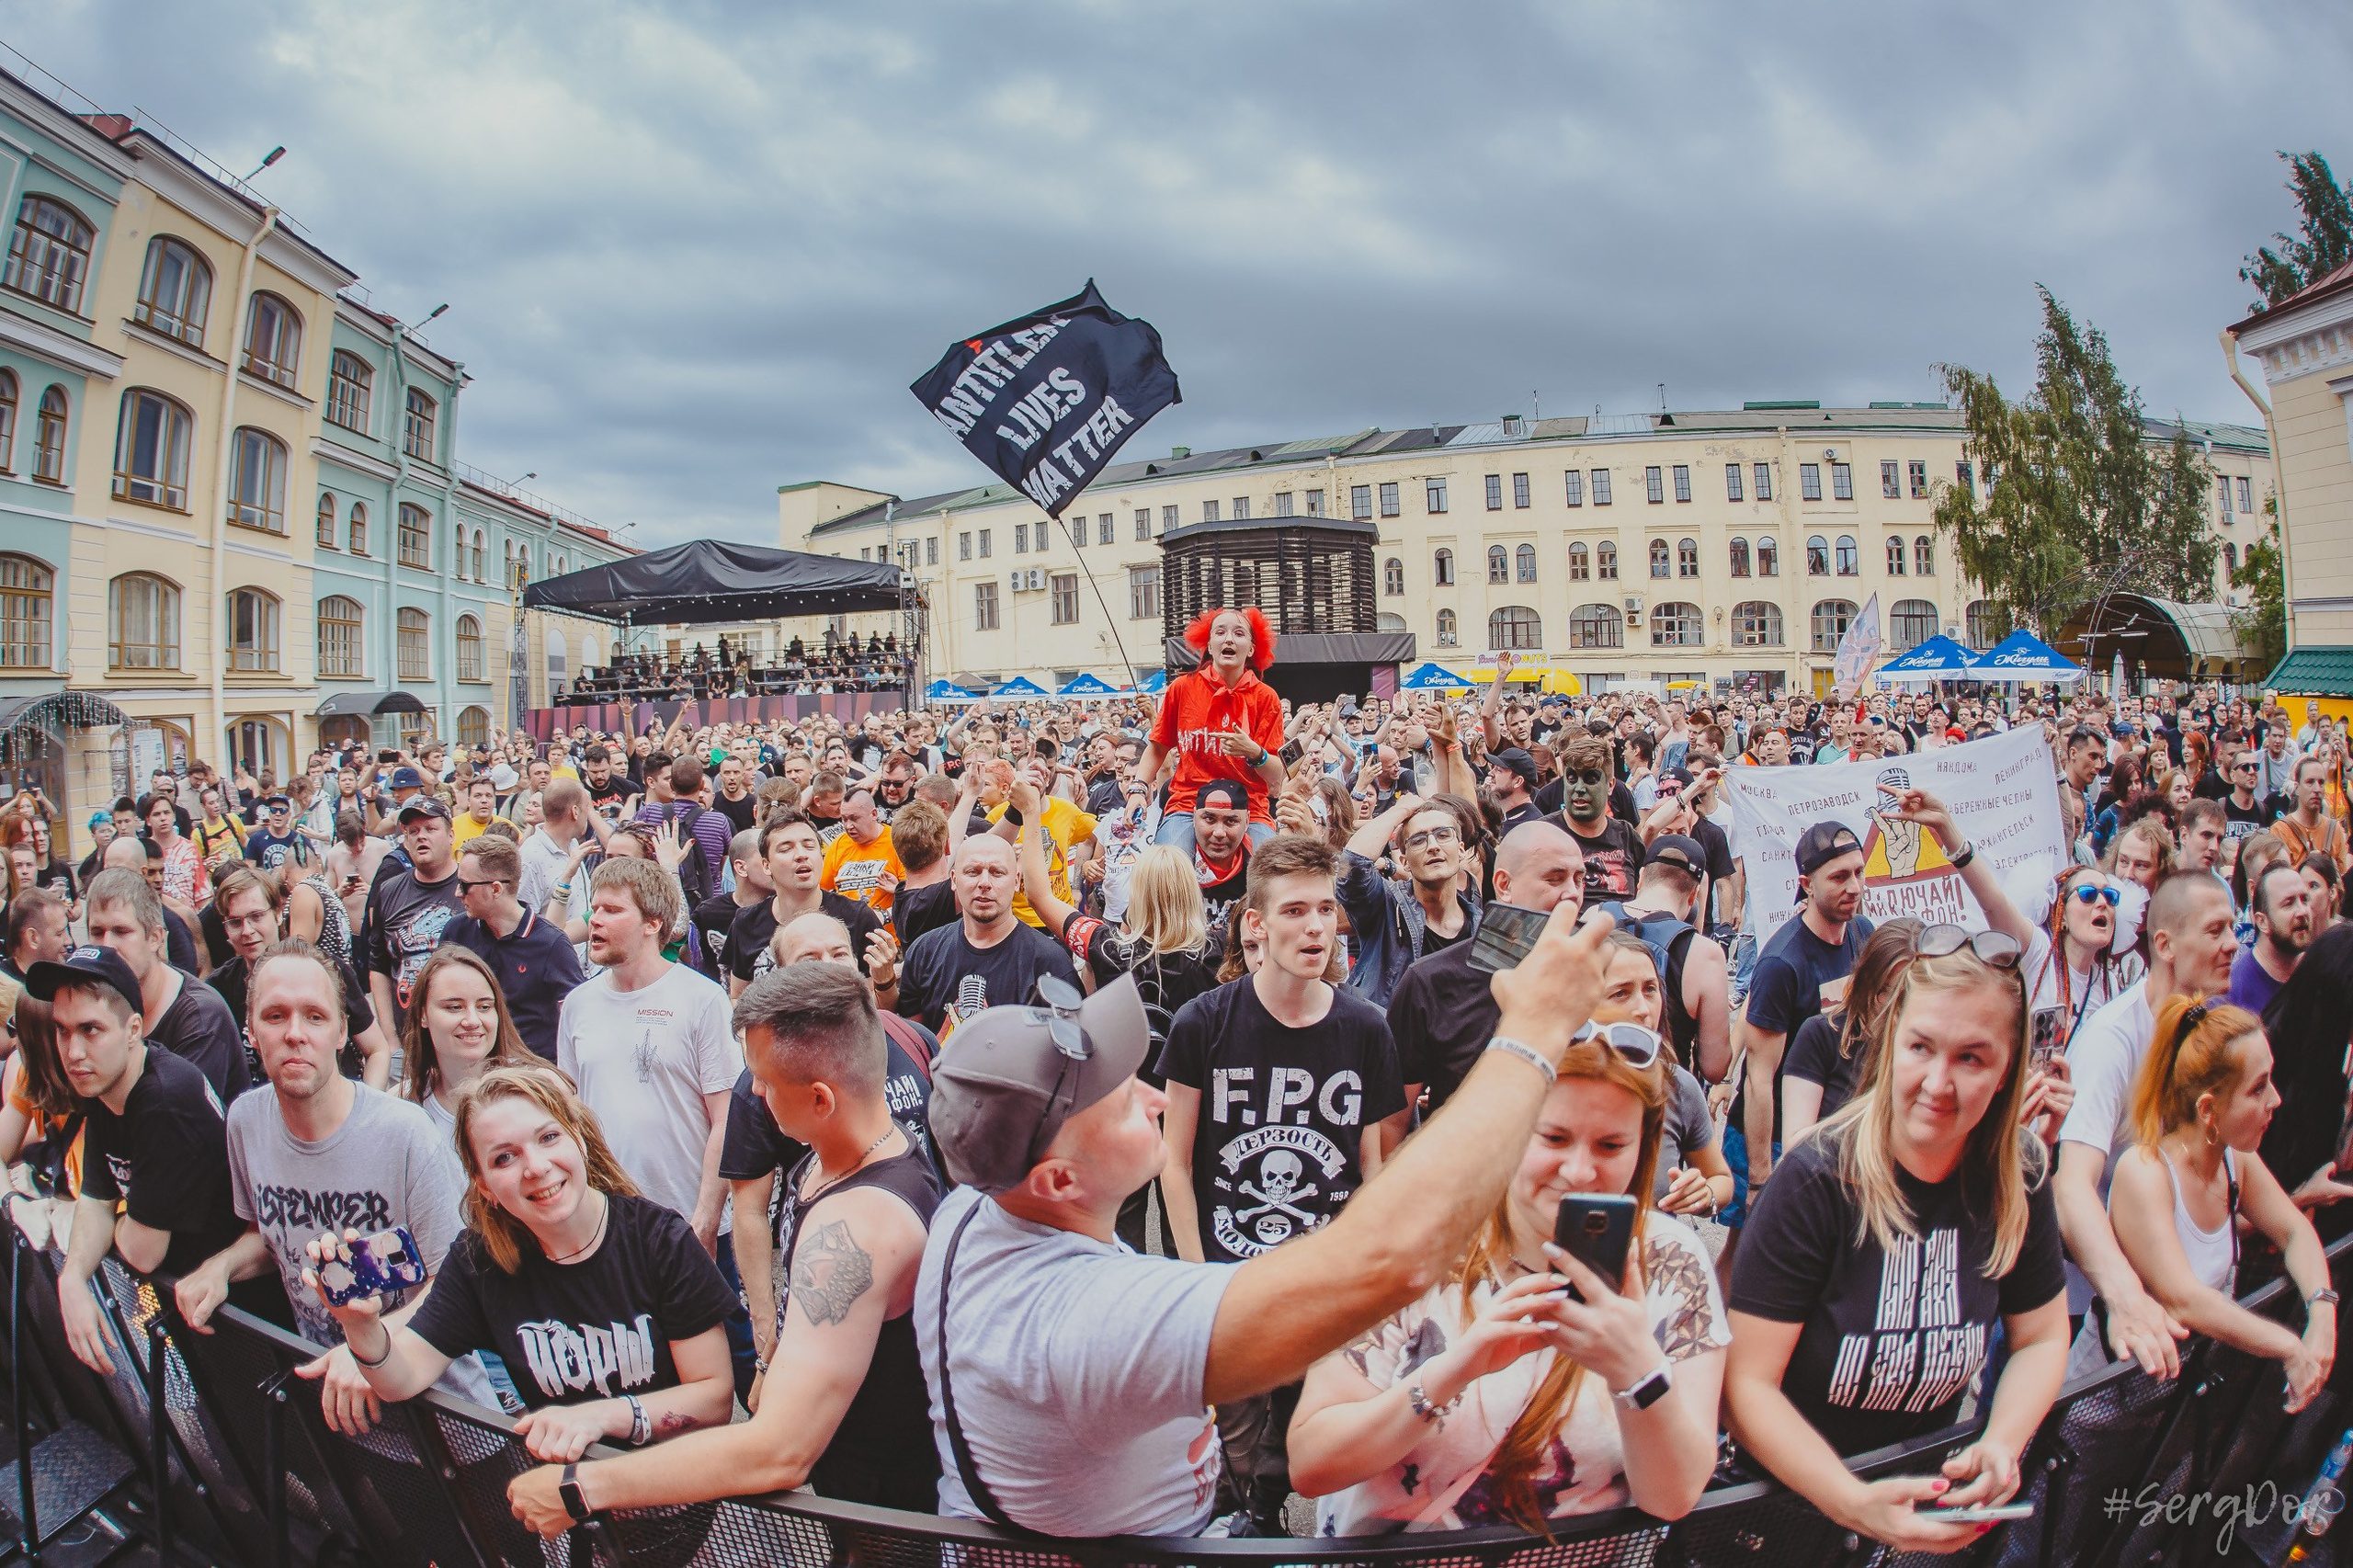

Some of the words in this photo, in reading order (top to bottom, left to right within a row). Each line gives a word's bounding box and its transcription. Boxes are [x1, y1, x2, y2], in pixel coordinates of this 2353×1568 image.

[996, 368, 1086, 450] LIVES
[1021, 395, 1134, 510] MATTER
[1508, 653, 1548, 664] ONUTS
[1937, 761, 1977, 774] НЯНДОМА
[1995, 747, 2042, 786] ЛЕНИНГРАД
[1740, 784, 1779, 801] МОСКВА
[1788, 790, 1861, 816] ПЕТРОЗАВОДСК
[1946, 796, 2000, 815] АБЕРЕЖНЫЕ
[2002, 788, 2033, 806] ЧЕЛНЫ
[1976, 812, 2035, 852] АРХАНГЕЛЬСК
[637, 1008, 674, 1017] MISSION
[1212, 1067, 1362, 1126] F.P.G
[1233, 1129, 1335, 1164] ДЕРЗОСТЬ
[1214, 1176, 1232, 1192] SINCE
[1329, 1190, 1349, 1201] 1998
[1258, 1221, 1288, 1236] 25
